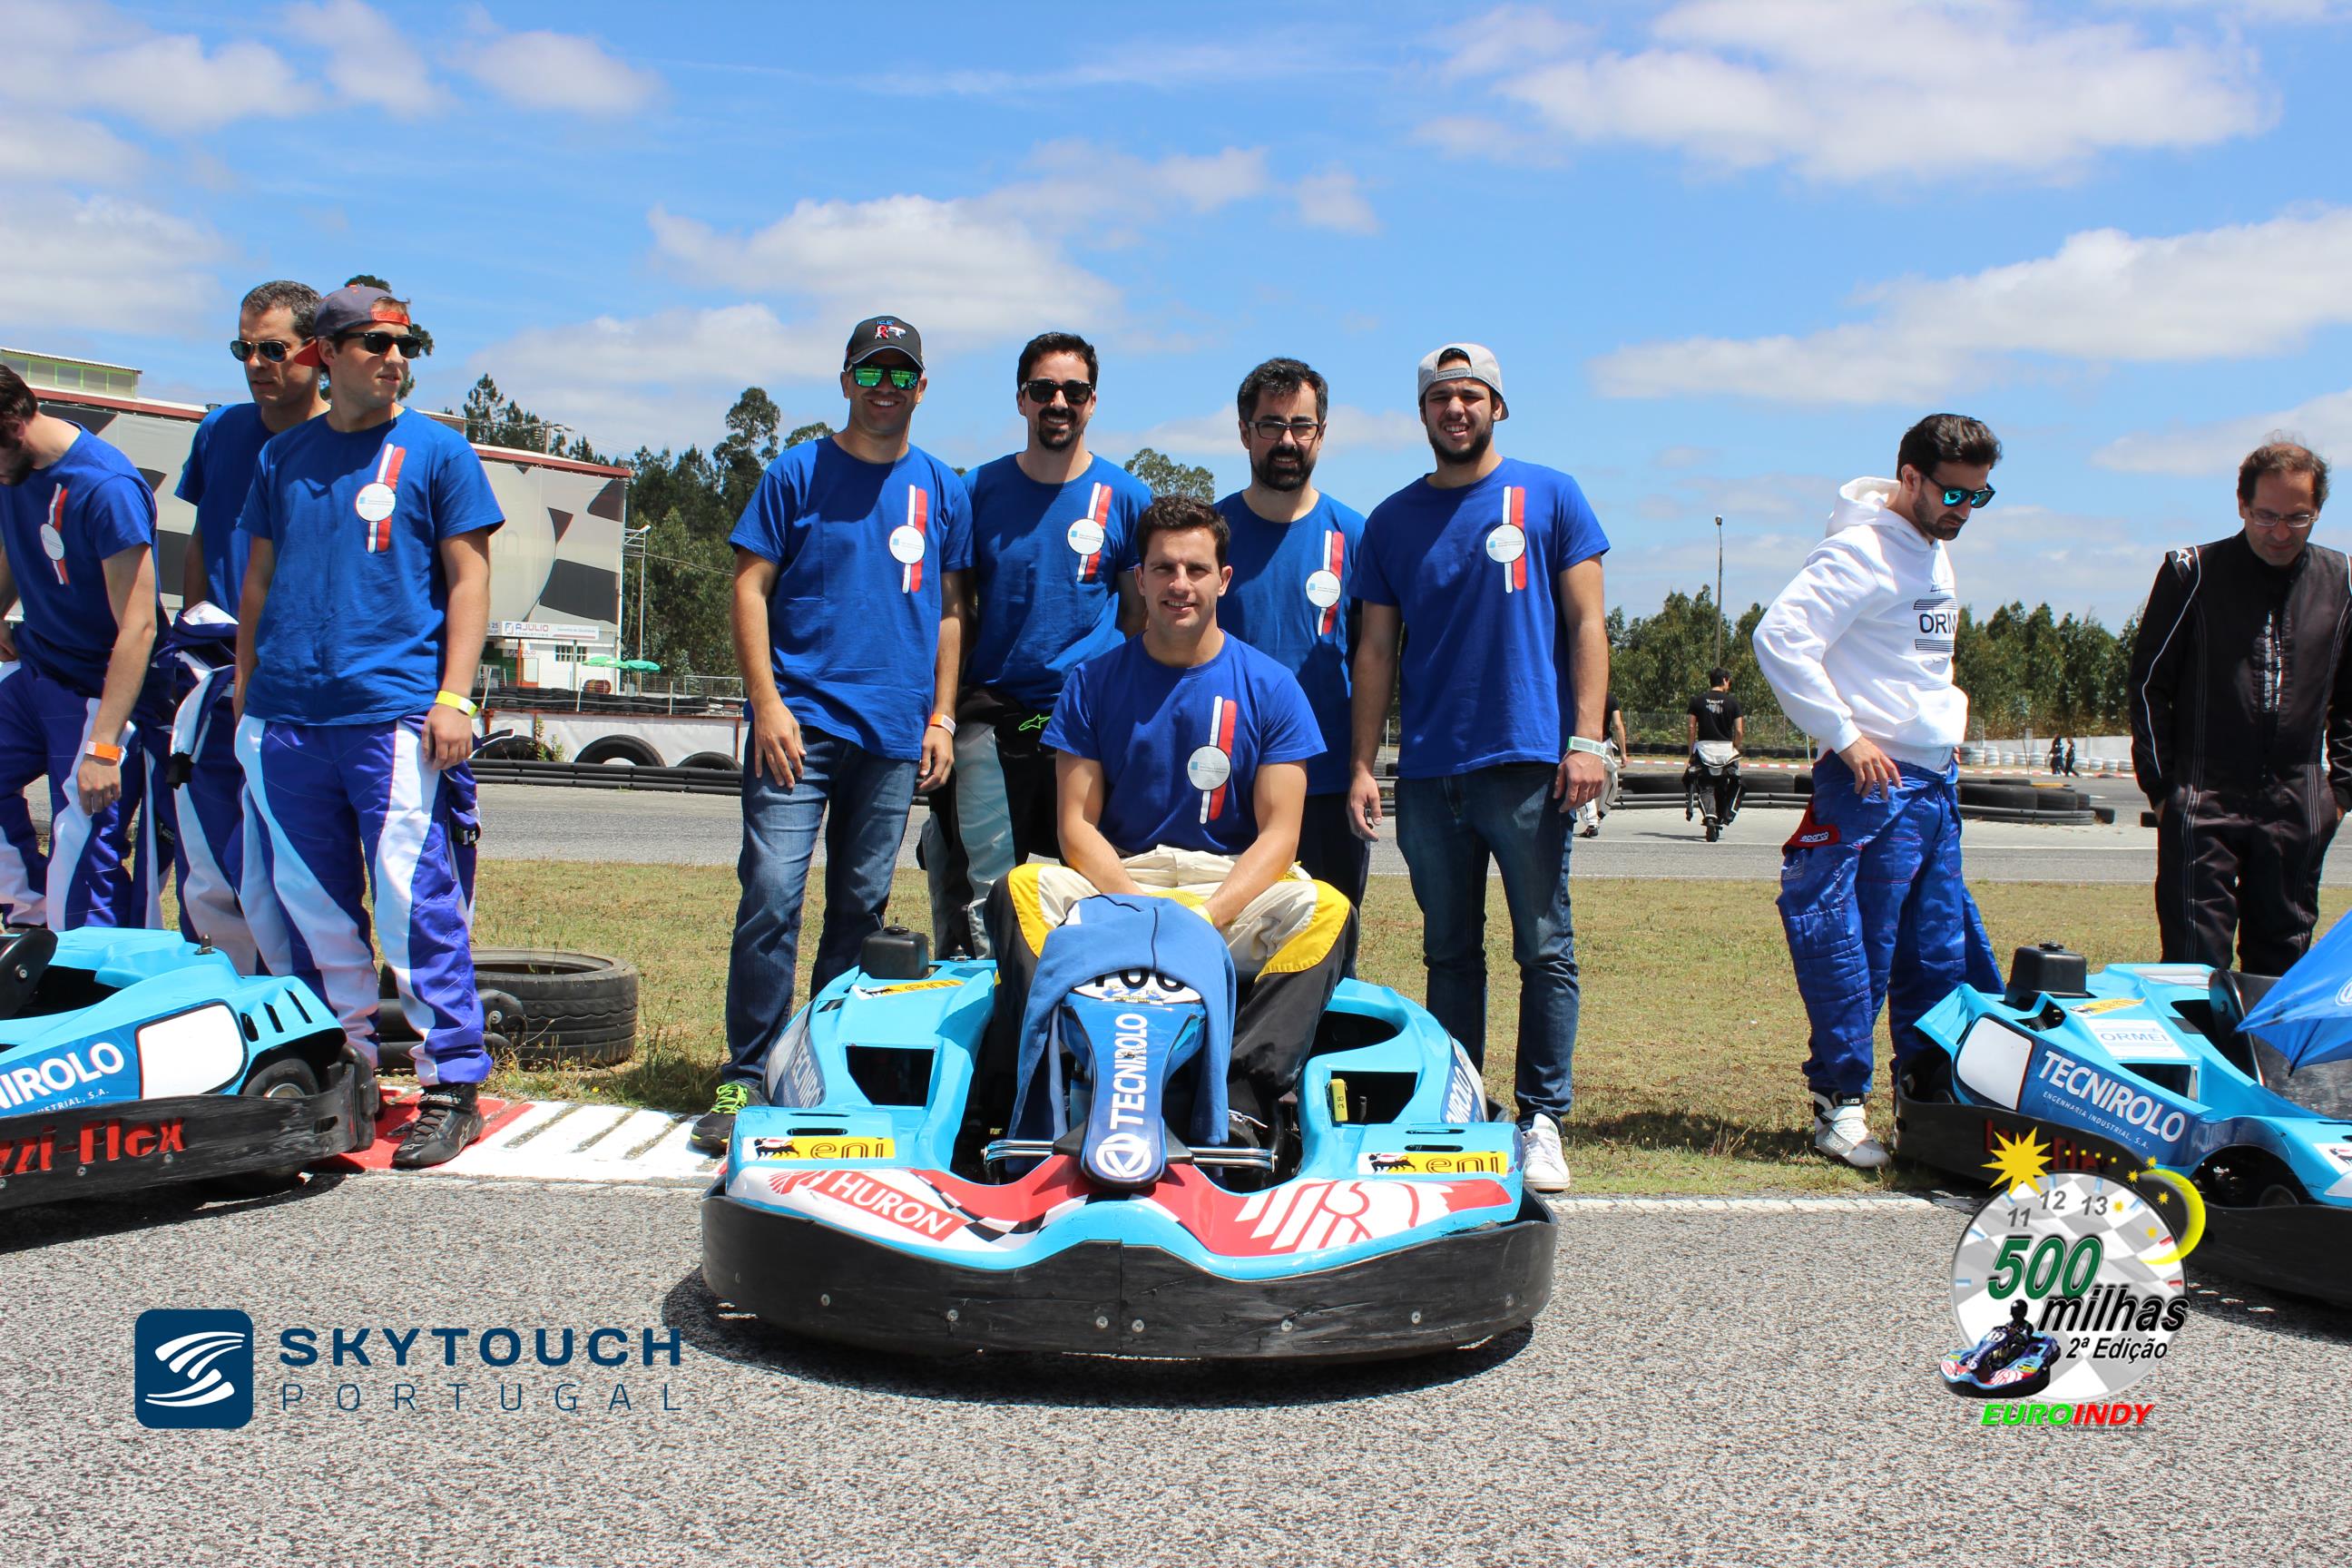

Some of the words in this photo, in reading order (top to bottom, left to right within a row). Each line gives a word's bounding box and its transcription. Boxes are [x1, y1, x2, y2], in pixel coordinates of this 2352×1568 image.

[1110, 1013, 1148, 1130] TECNIROLO
[2038, 1050, 2186, 1142] TECNIROLO
[2043, 1091, 2086, 1118] ENGENHARIA
[810, 1137, 884, 1159] eni
[1426, 1151, 1499, 1173] eni
[828, 1172, 953, 1235] HURON
